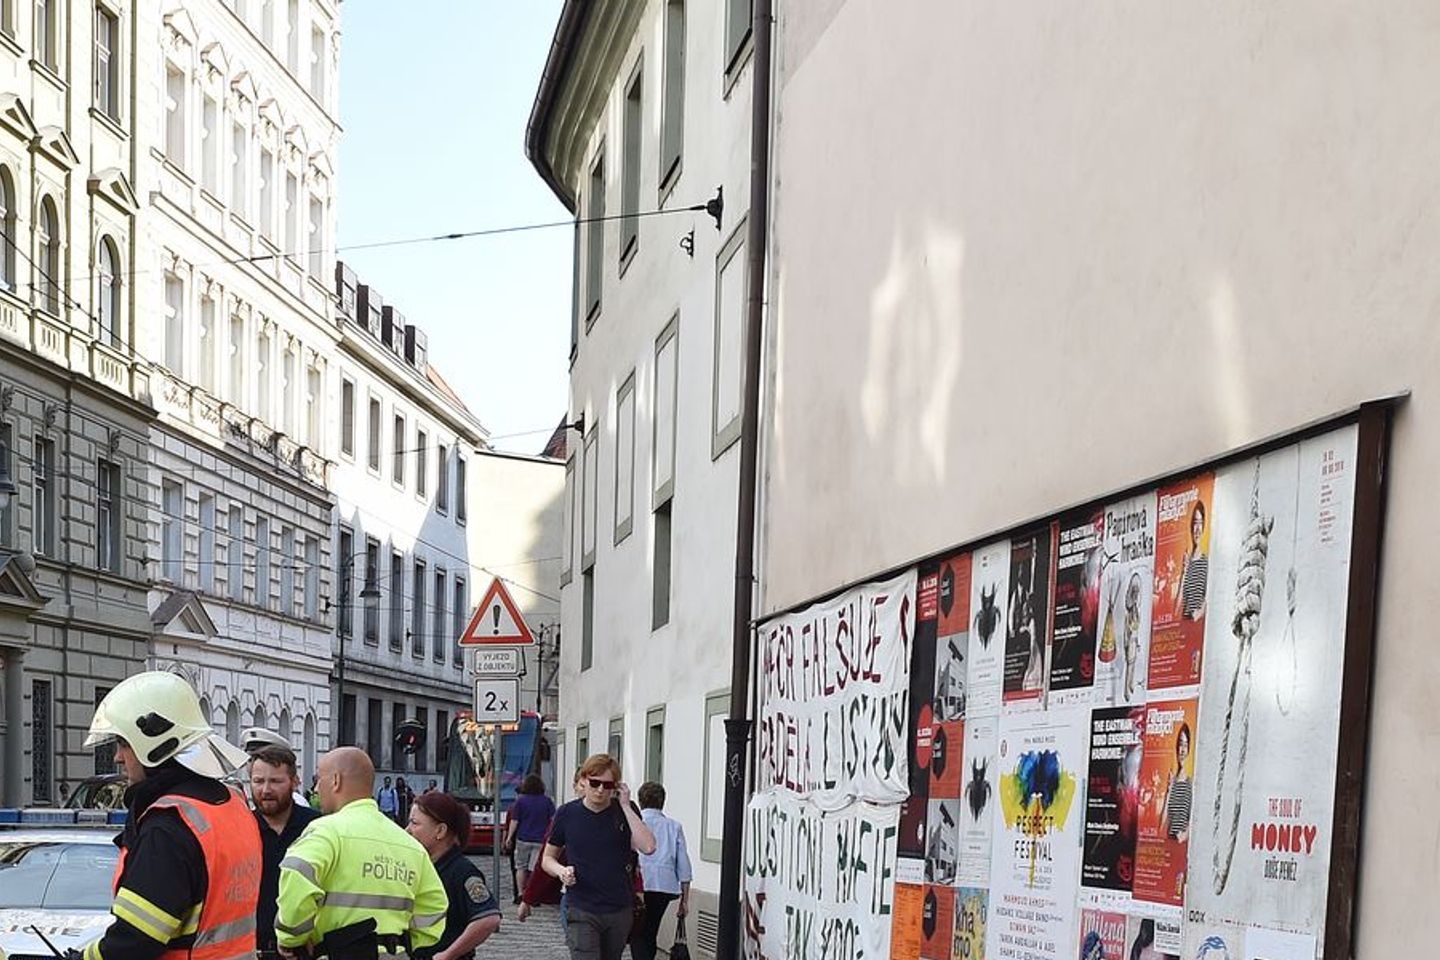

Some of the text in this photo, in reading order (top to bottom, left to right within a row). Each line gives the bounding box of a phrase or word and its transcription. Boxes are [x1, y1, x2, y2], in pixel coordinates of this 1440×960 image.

[1016, 815, 1054, 837] RESPECT
[1251, 822, 1317, 855] MONEY
[1014, 839, 1053, 862] FESTIVAL
